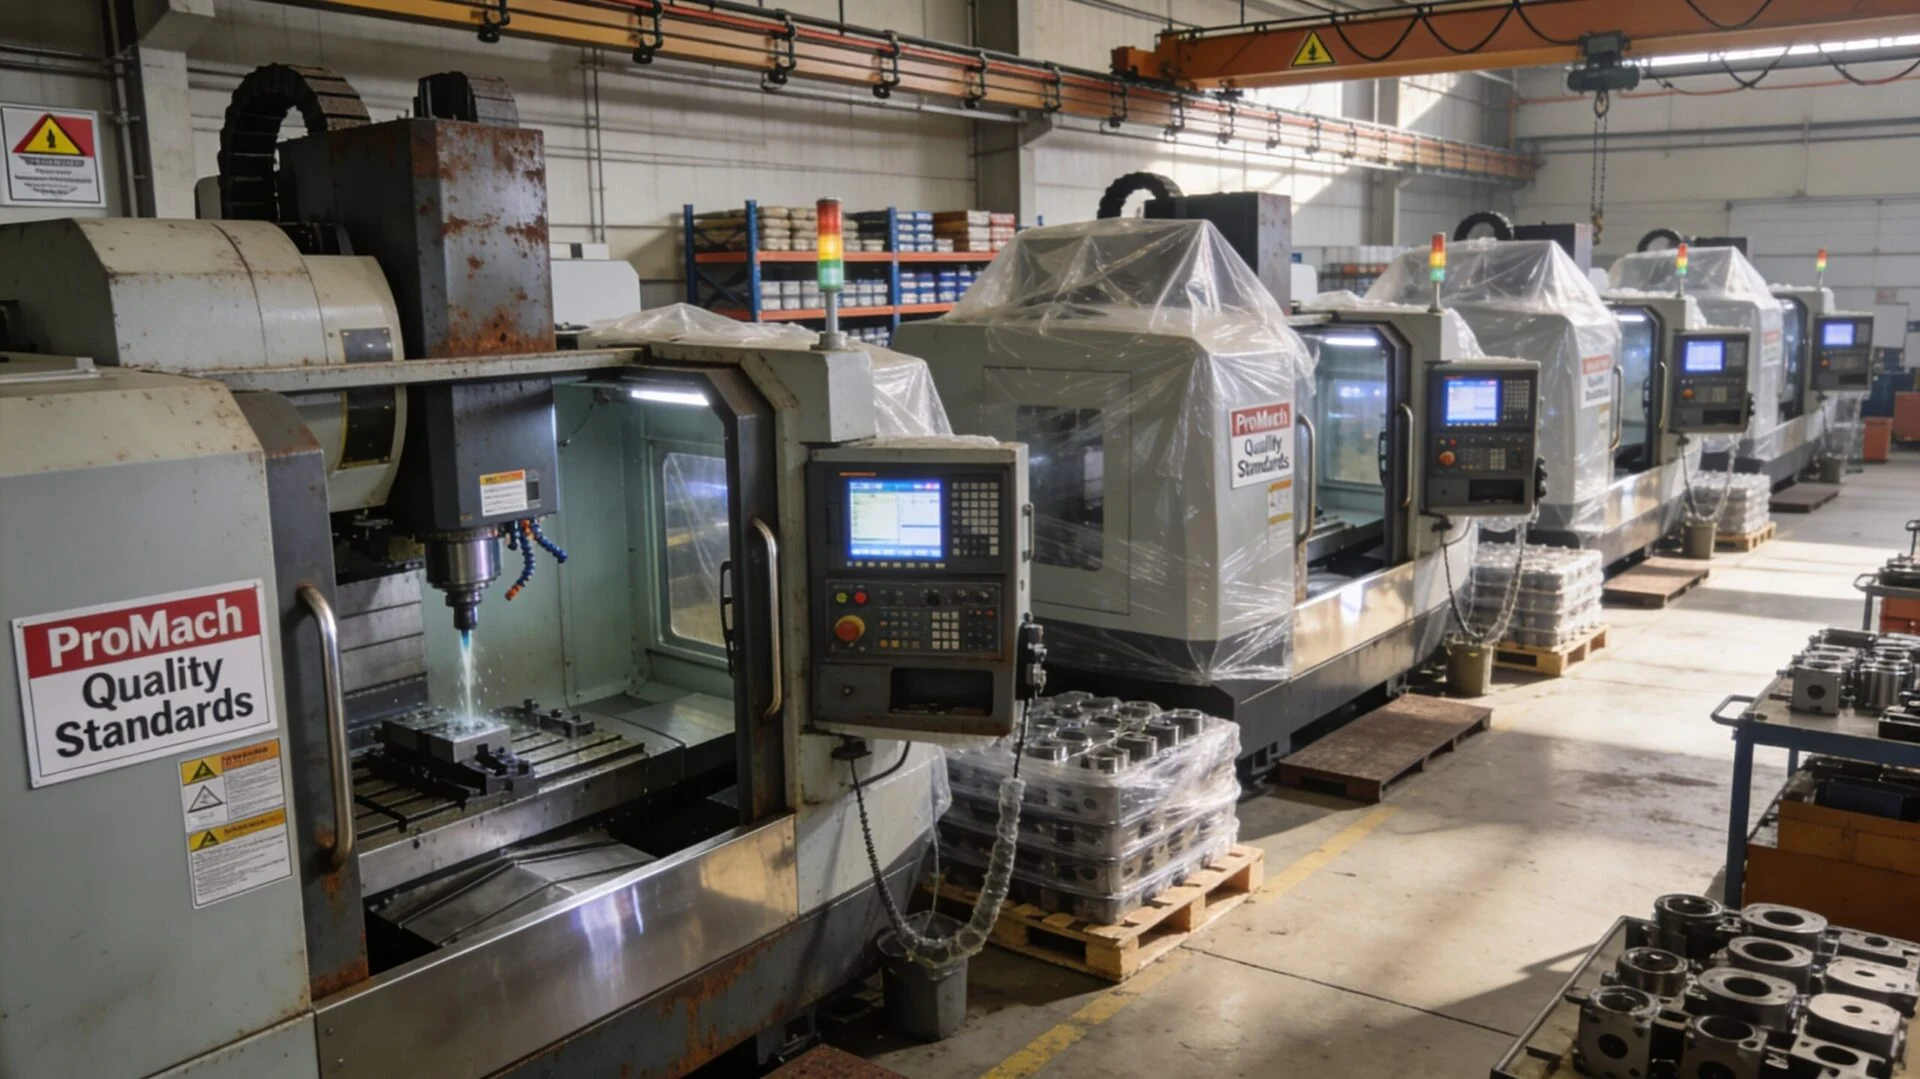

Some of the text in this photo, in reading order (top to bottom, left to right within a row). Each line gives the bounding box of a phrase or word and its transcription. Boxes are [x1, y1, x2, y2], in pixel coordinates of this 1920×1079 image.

[48, 598, 243, 668] ProMach
[82, 656, 223, 711] Quality
[55, 687, 254, 758] Standards
